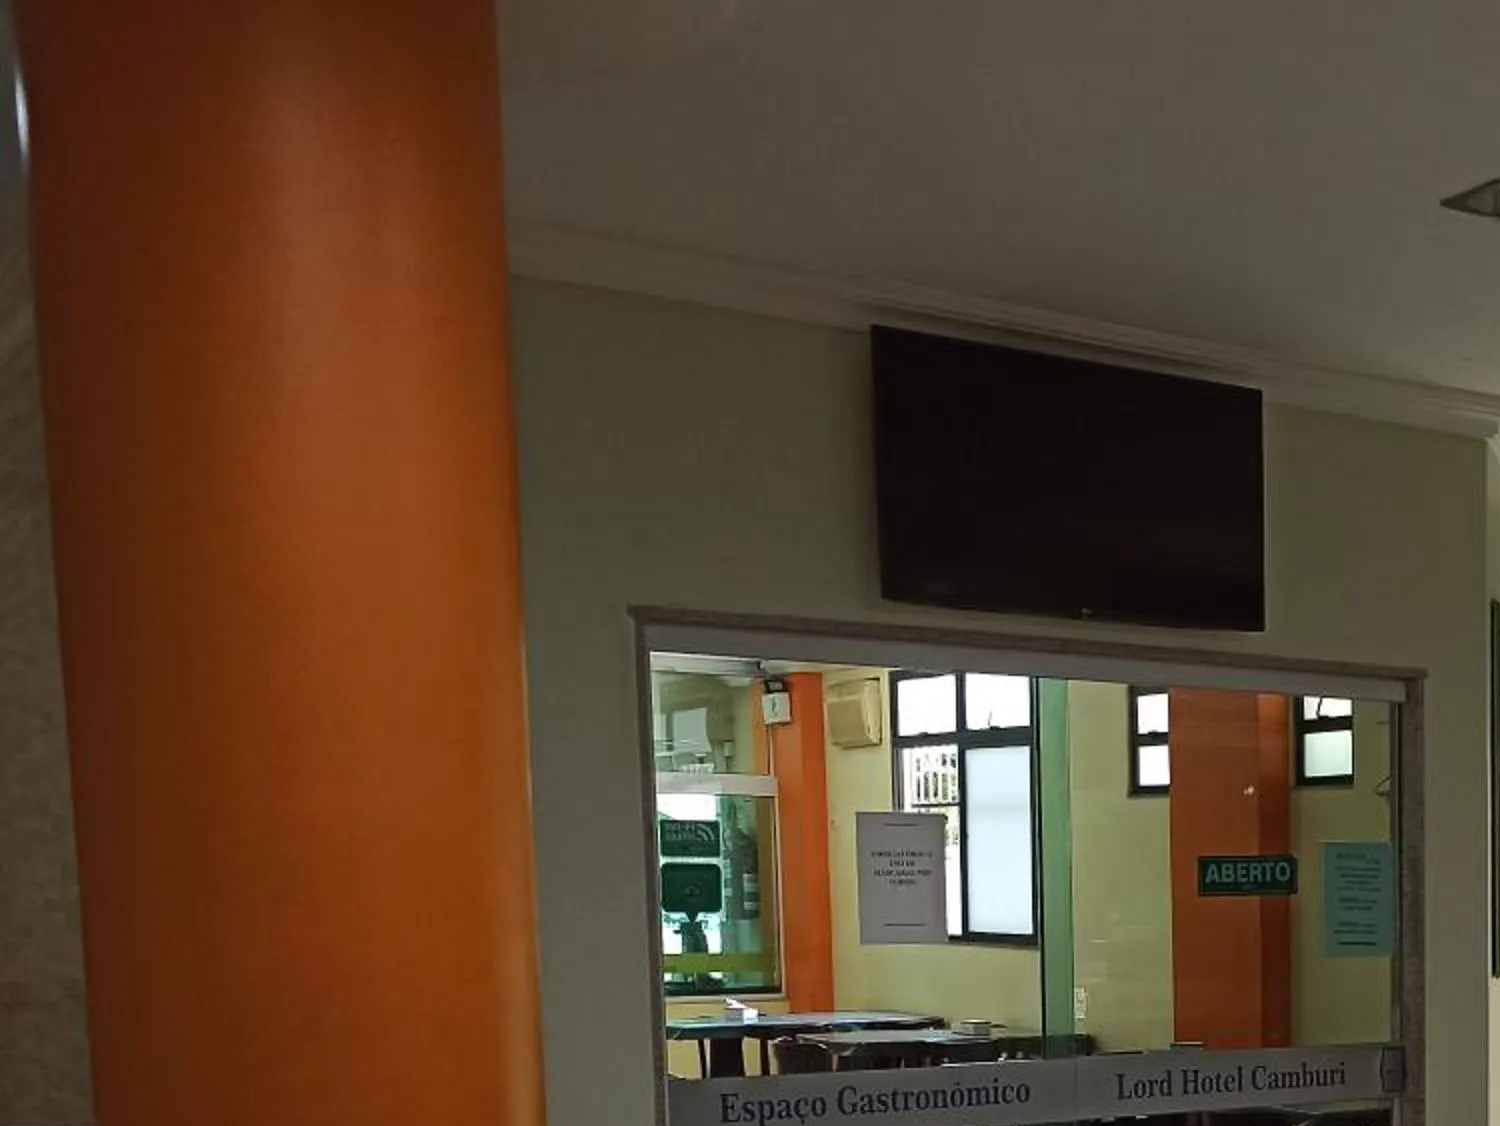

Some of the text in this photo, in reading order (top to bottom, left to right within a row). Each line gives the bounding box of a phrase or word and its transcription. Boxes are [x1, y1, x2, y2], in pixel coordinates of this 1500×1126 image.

[1204, 861, 1292, 885] ABERTO
[1116, 1061, 1346, 1100] Lord Hotel Camburi
